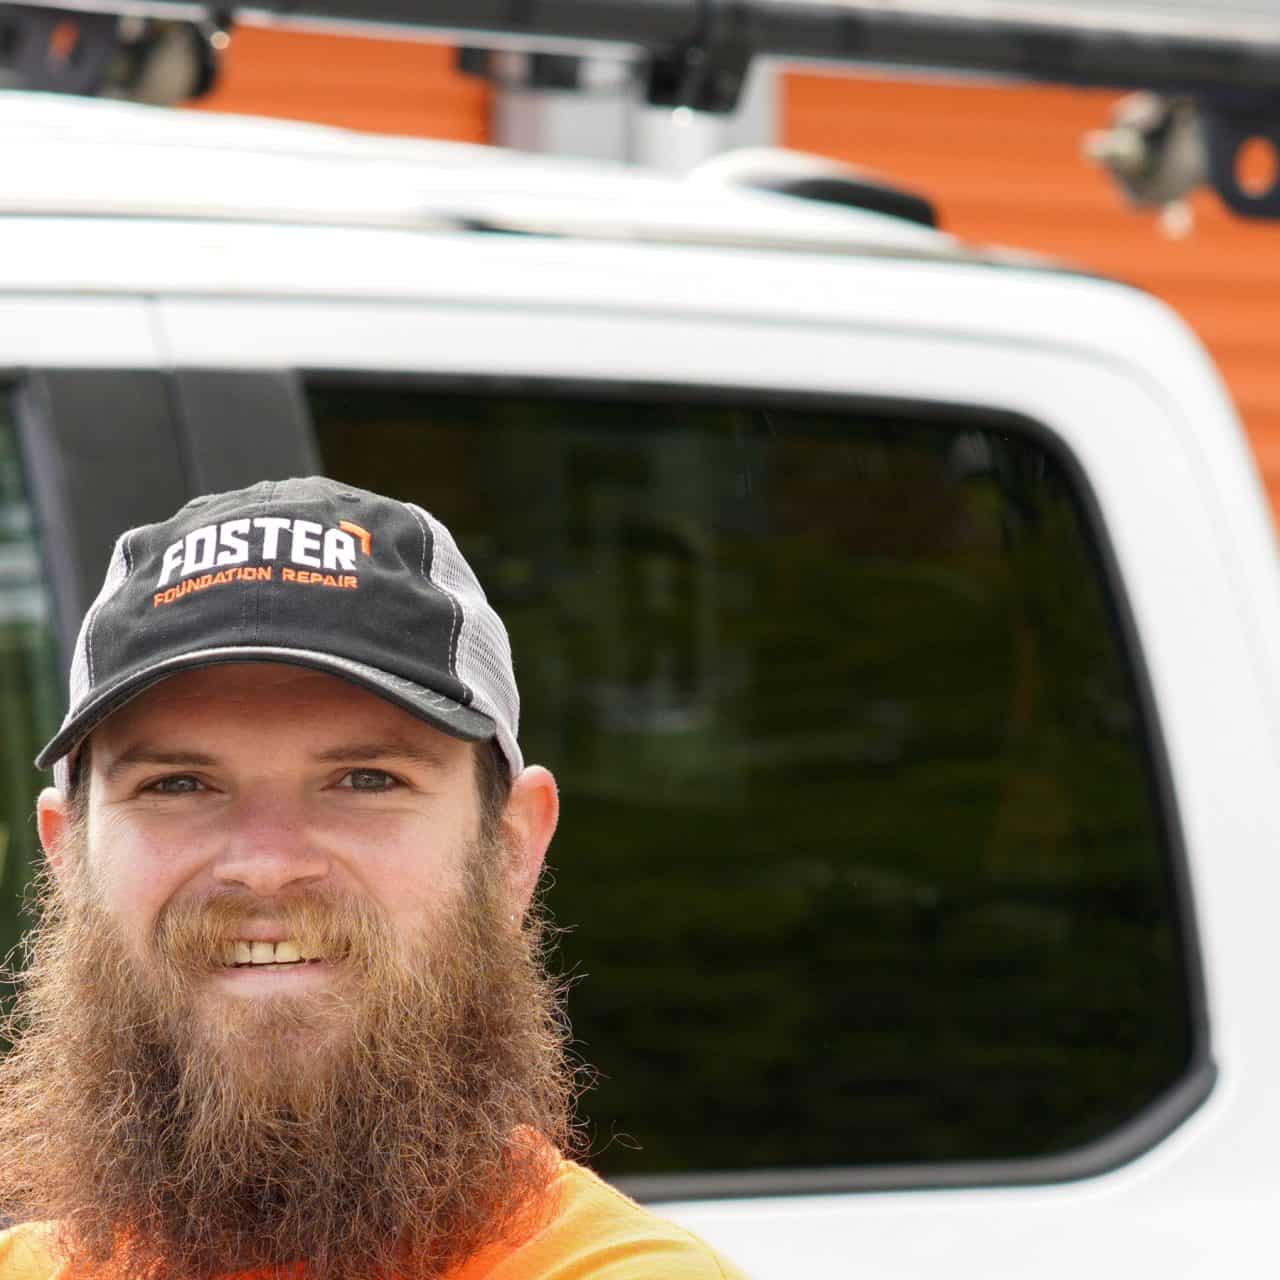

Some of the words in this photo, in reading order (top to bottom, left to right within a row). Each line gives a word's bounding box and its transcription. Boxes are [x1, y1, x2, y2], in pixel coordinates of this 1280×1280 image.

[157, 517, 357, 588] FOSTER
[153, 566, 271, 608] FOUNDATION
[282, 567, 358, 588] REPAIR
